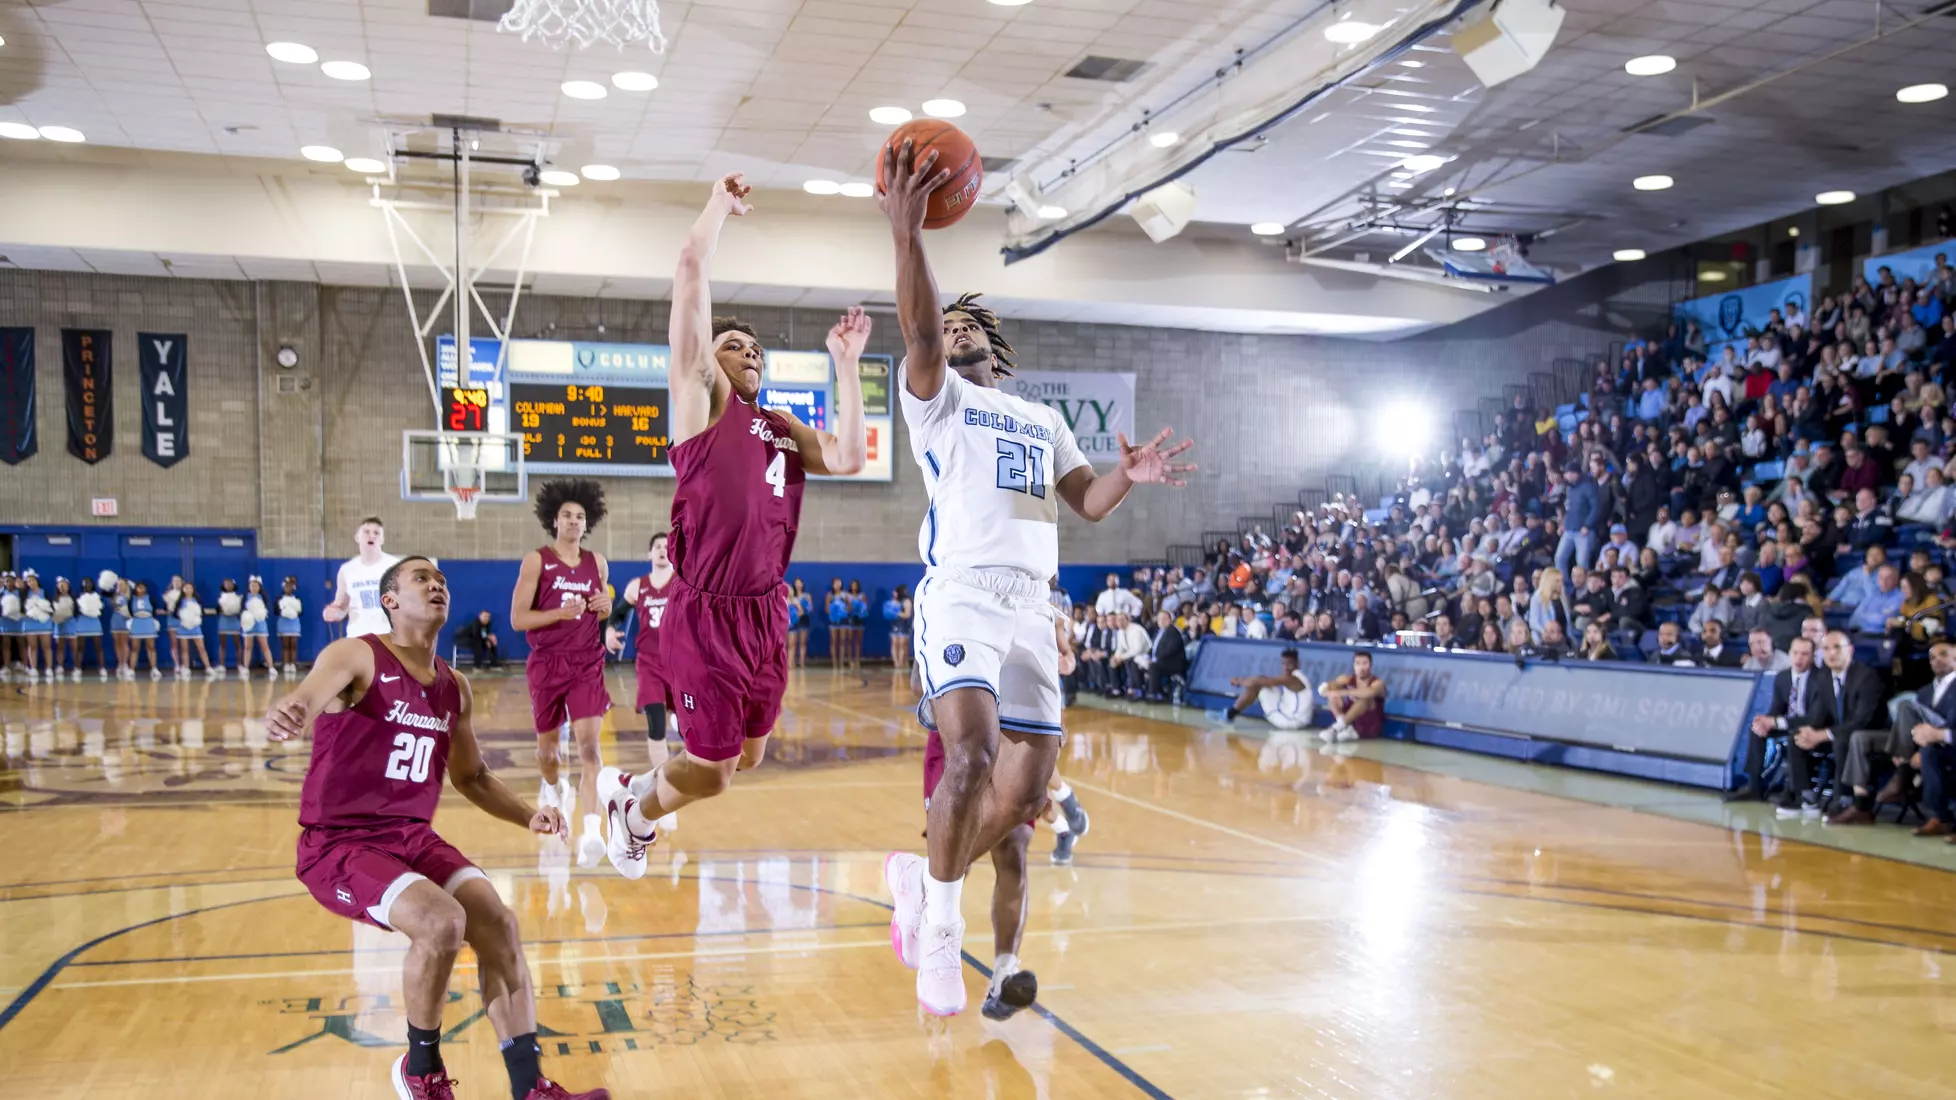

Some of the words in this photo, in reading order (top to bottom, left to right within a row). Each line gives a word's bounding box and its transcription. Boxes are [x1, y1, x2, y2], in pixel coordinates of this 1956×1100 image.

[599, 352, 666, 369] COLUM
[81, 335, 98, 459] PRINCETON
[566, 384, 604, 402] 9:40
[1042, 383, 1069, 395] THE
[152, 340, 175, 456] YALE
[450, 402, 481, 430] 27
[515, 401, 565, 415] COLUMBIA
[613, 404, 659, 418] HARVARD
[1041, 398, 1115, 433] VY
[521, 413, 540, 428] 19
[571, 416, 607, 427] BONUS
[631, 417, 650, 431] 16
[523, 433, 542, 443] ULS
[635, 436, 667, 446] FOULS
[1077, 436, 1118, 452] GUE
[575, 447, 603, 458] FULL
[765, 451, 786, 498] 4
[996, 437, 1046, 500] 21
[95, 502, 114, 514] EXIT
[552, 576, 592, 592] Harvard
[684, 693, 695, 710] H
[1455, 680, 1545, 711] POWERED
[1550, 690, 1583, 716] BY
[1585, 692, 1628, 720] JMI
[1634, 697, 1740, 735] SPORTS
[384, 700, 451, 732] Harvard
[384, 732, 436, 783] 20
[336, 889, 352, 904] H
